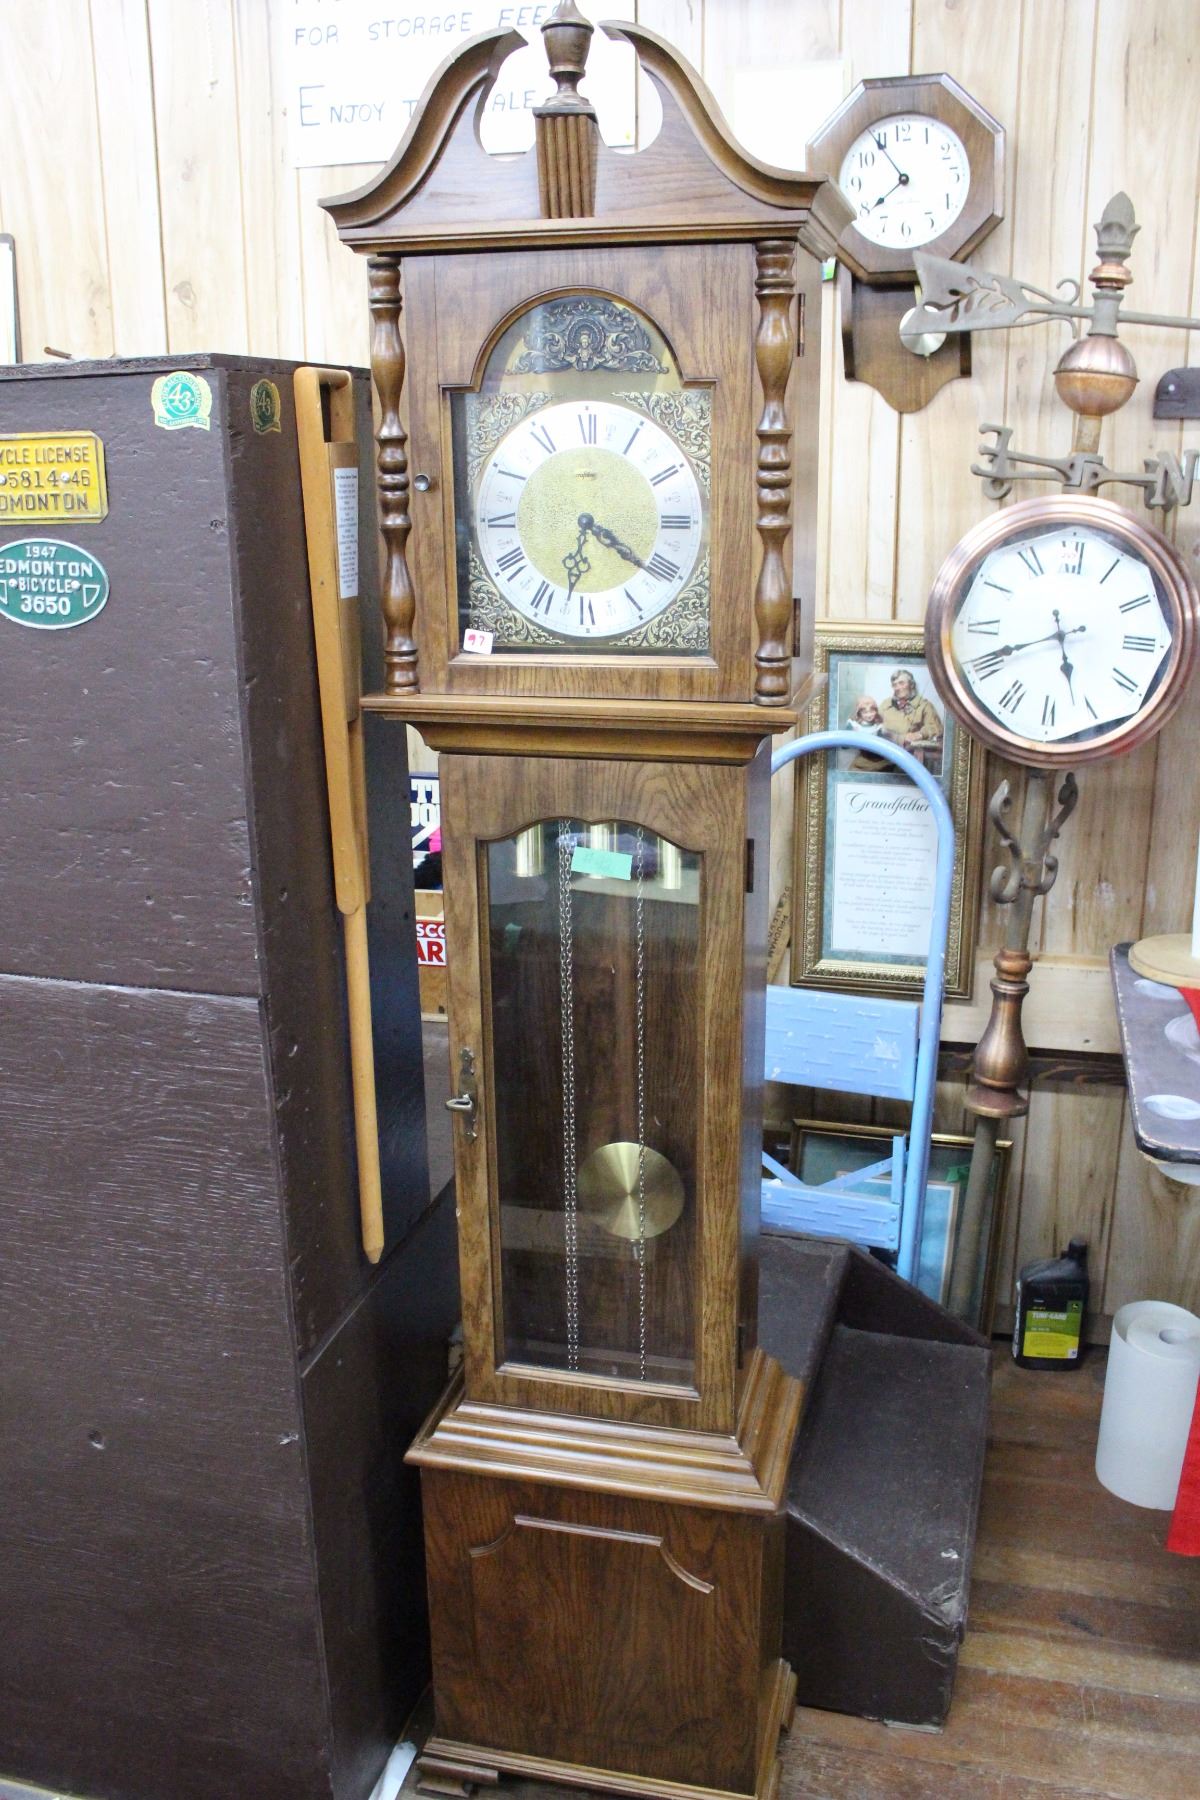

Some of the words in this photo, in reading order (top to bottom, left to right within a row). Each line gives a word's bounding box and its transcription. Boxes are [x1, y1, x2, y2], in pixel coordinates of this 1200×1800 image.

[295, 24, 338, 46] FOR
[368, 12, 472, 41] STORAGE
[299, 84, 384, 126] ENJOY
[896, 124, 911, 142] 12
[859, 151, 875, 168] 10
[850, 176, 862, 192] 9
[167, 383, 194, 413] 43
[35, 446, 90, 464] LICENSE
[8, 470, 59, 488] 5814
[72, 469, 90, 487] 46
[25, 545, 57, 558] 1947
[0, 560, 93, 577] EDMONTON
[18, 577, 72, 593] BICYCLE
[20, 594, 71, 615] 3650
[845, 792, 930, 817] Grandfather
